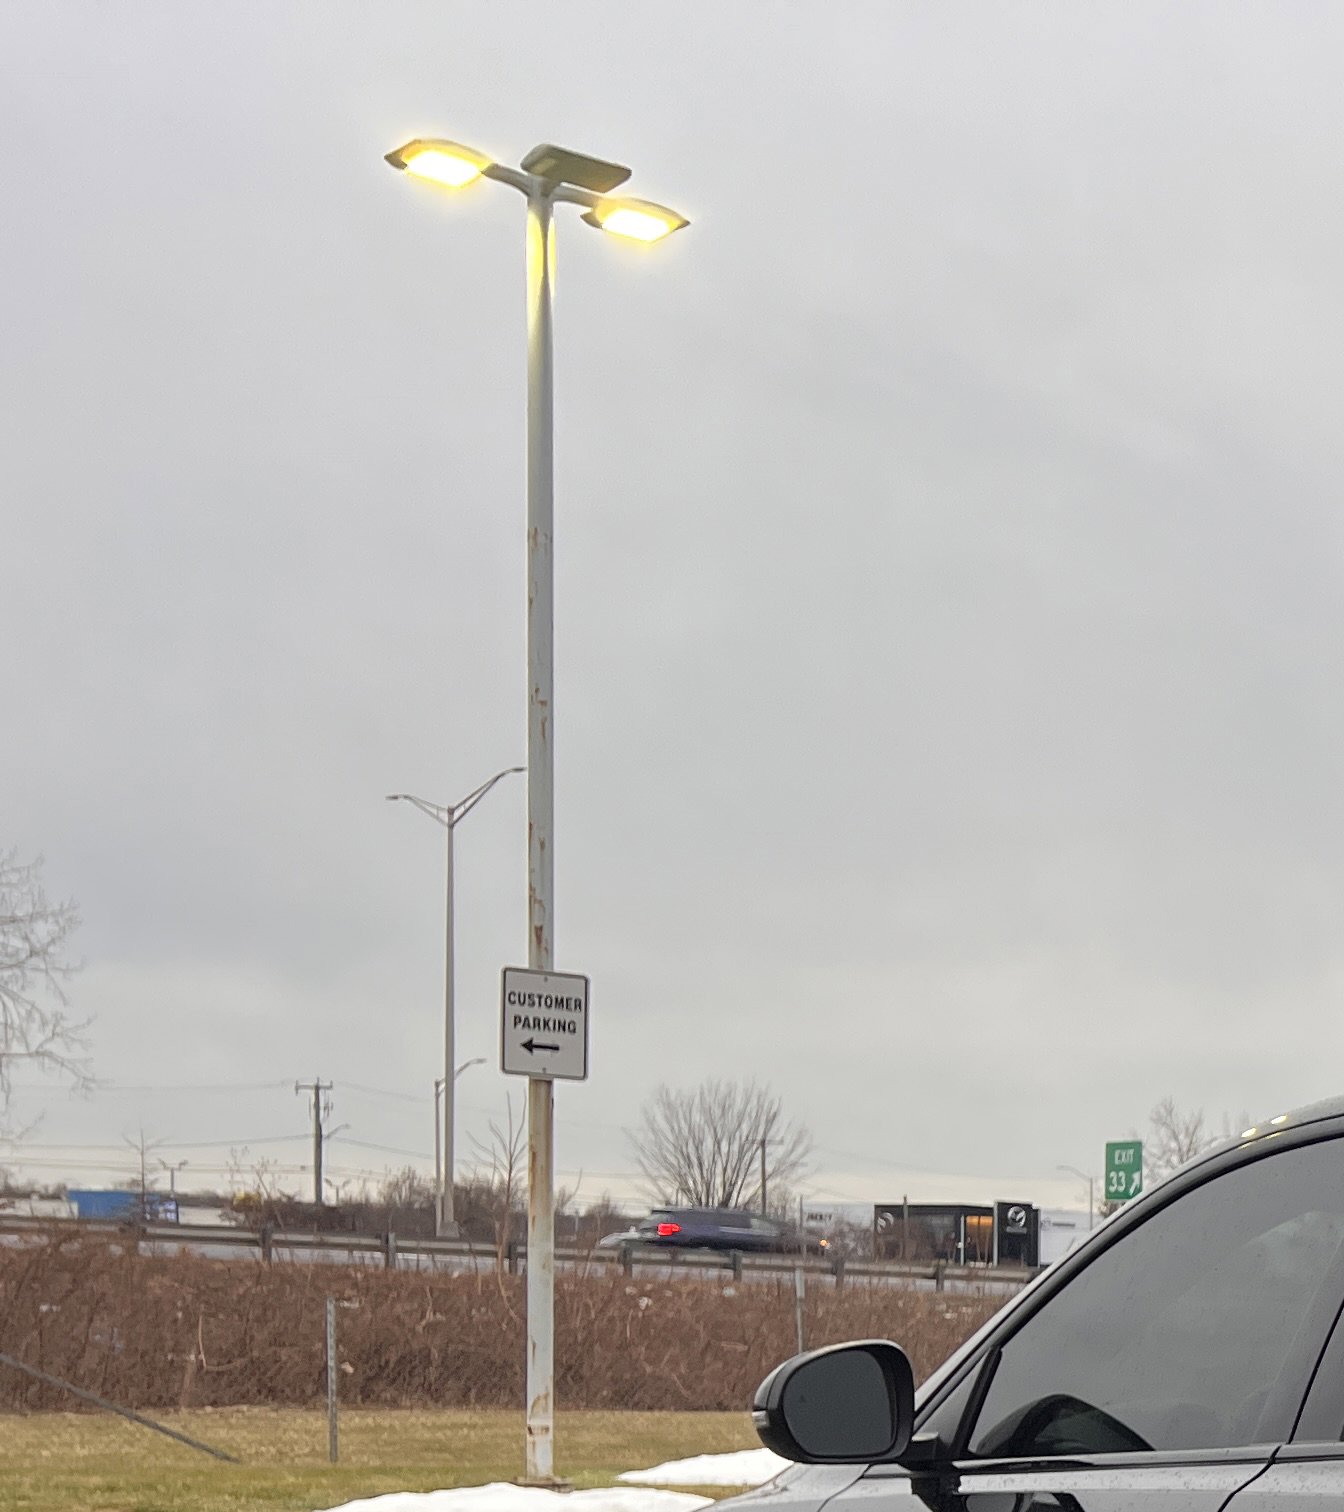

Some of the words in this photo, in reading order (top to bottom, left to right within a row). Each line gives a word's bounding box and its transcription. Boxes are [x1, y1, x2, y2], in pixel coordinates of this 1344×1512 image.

[508, 991, 582, 1012] CUSTOMER
[513, 1014, 577, 1034] PARKING
[1115, 1149, 1135, 1165] EXIT
[1109, 1170, 1126, 1193] 33
